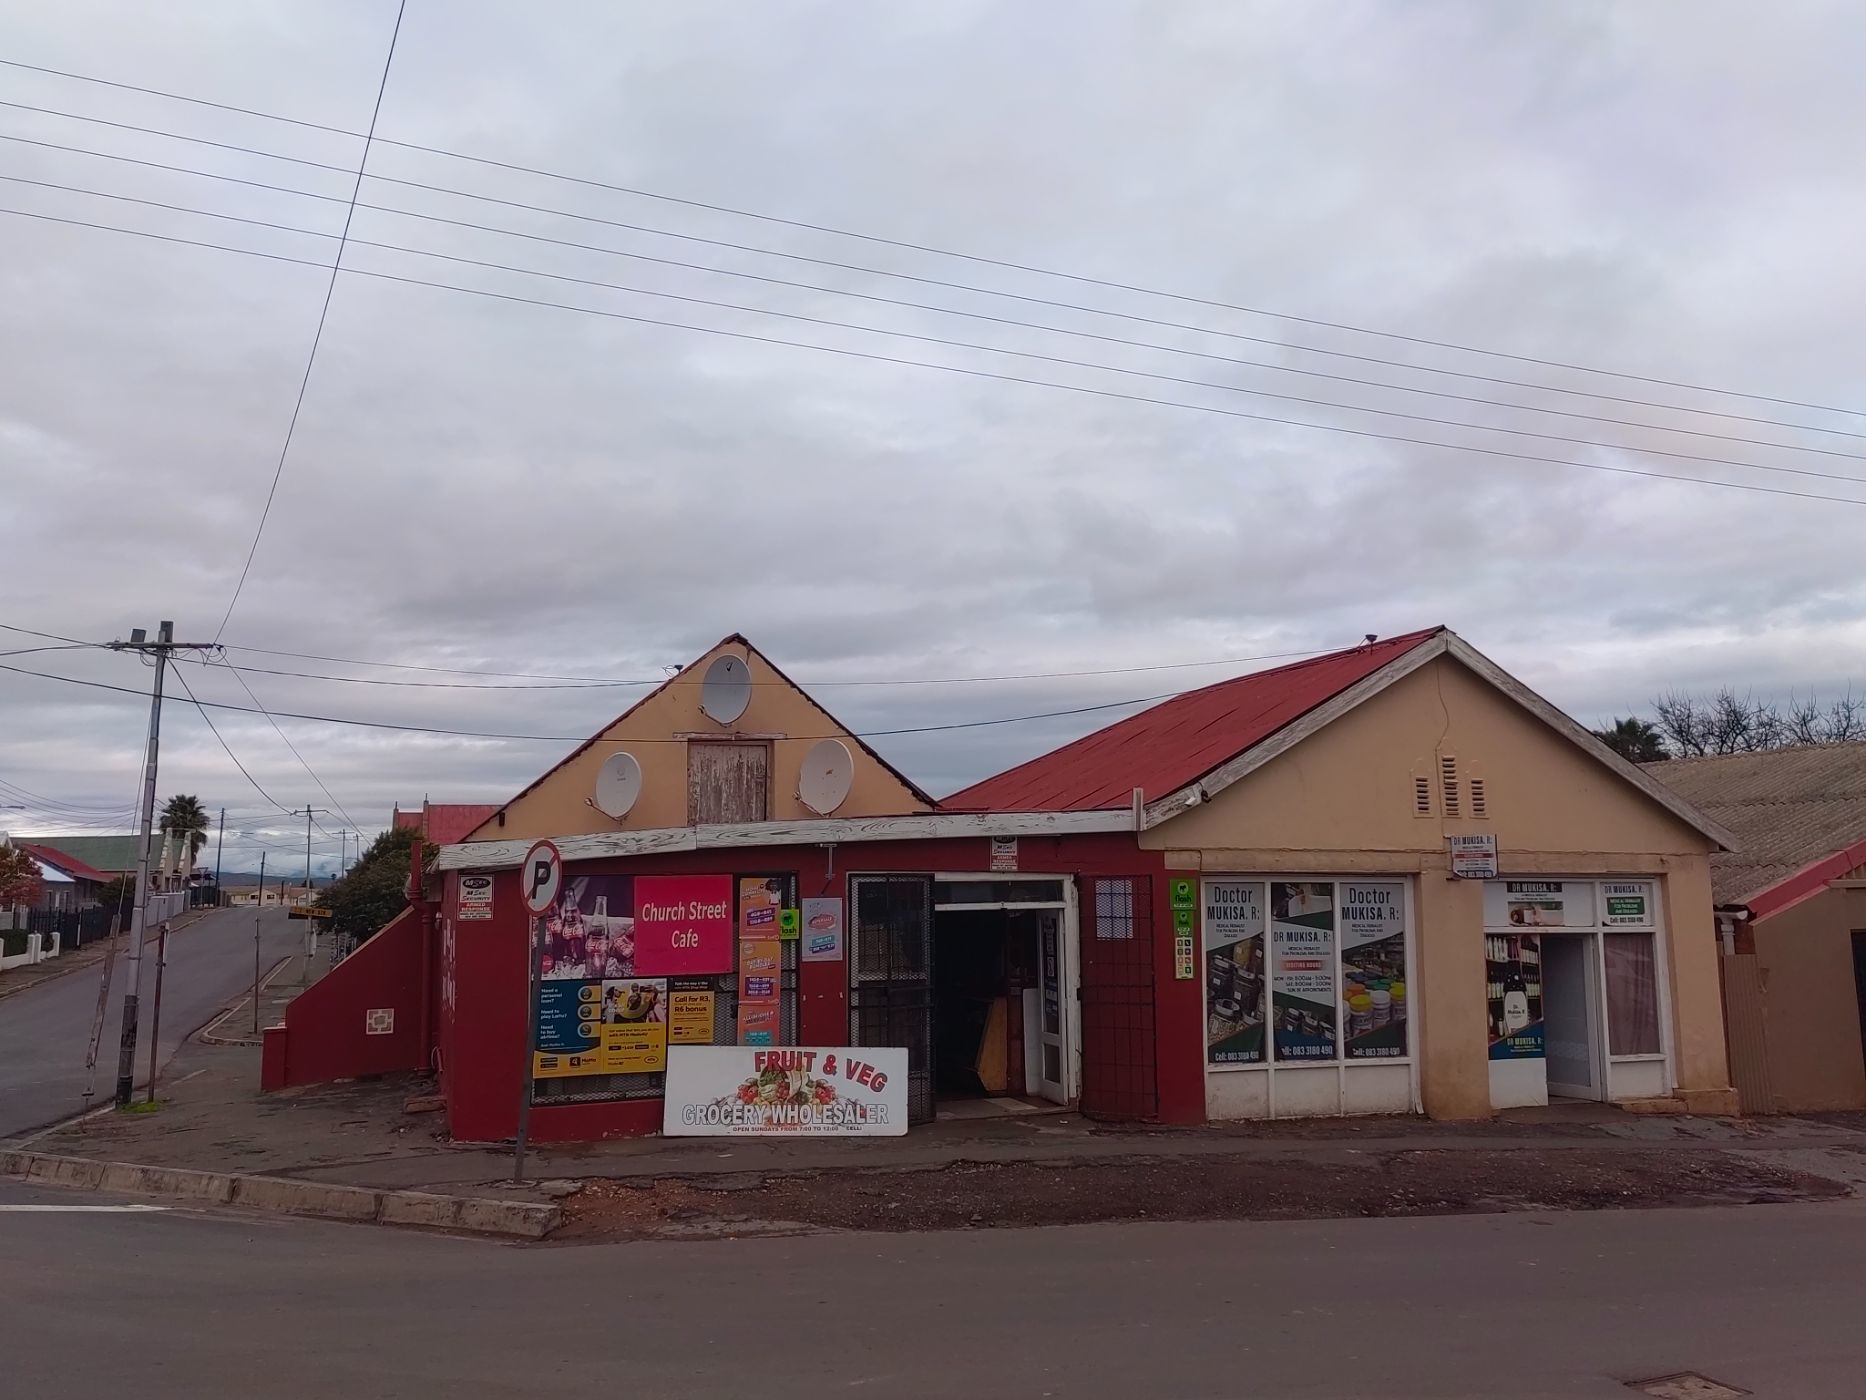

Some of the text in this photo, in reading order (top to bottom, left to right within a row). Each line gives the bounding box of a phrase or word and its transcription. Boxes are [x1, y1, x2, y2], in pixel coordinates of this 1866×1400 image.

[532, 861, 551, 899] P
[1214, 886, 1252, 903] Doctor
[1350, 887, 1390, 904] Doctor
[642, 902, 685, 921] Church
[688, 900, 727, 920] Street
[1207, 906, 1260, 920] MUKISA. R:
[1342, 907, 1399, 920] MUKISA. R:
[671, 929, 698, 948] Cafe
[1274, 932, 1284, 942] DR
[1293, 1046, 1304, 1056] 083
[754, 1051, 888, 1092] FRUIT & VEG
[682, 1103, 889, 1126] GROCERY WHOLESALER
